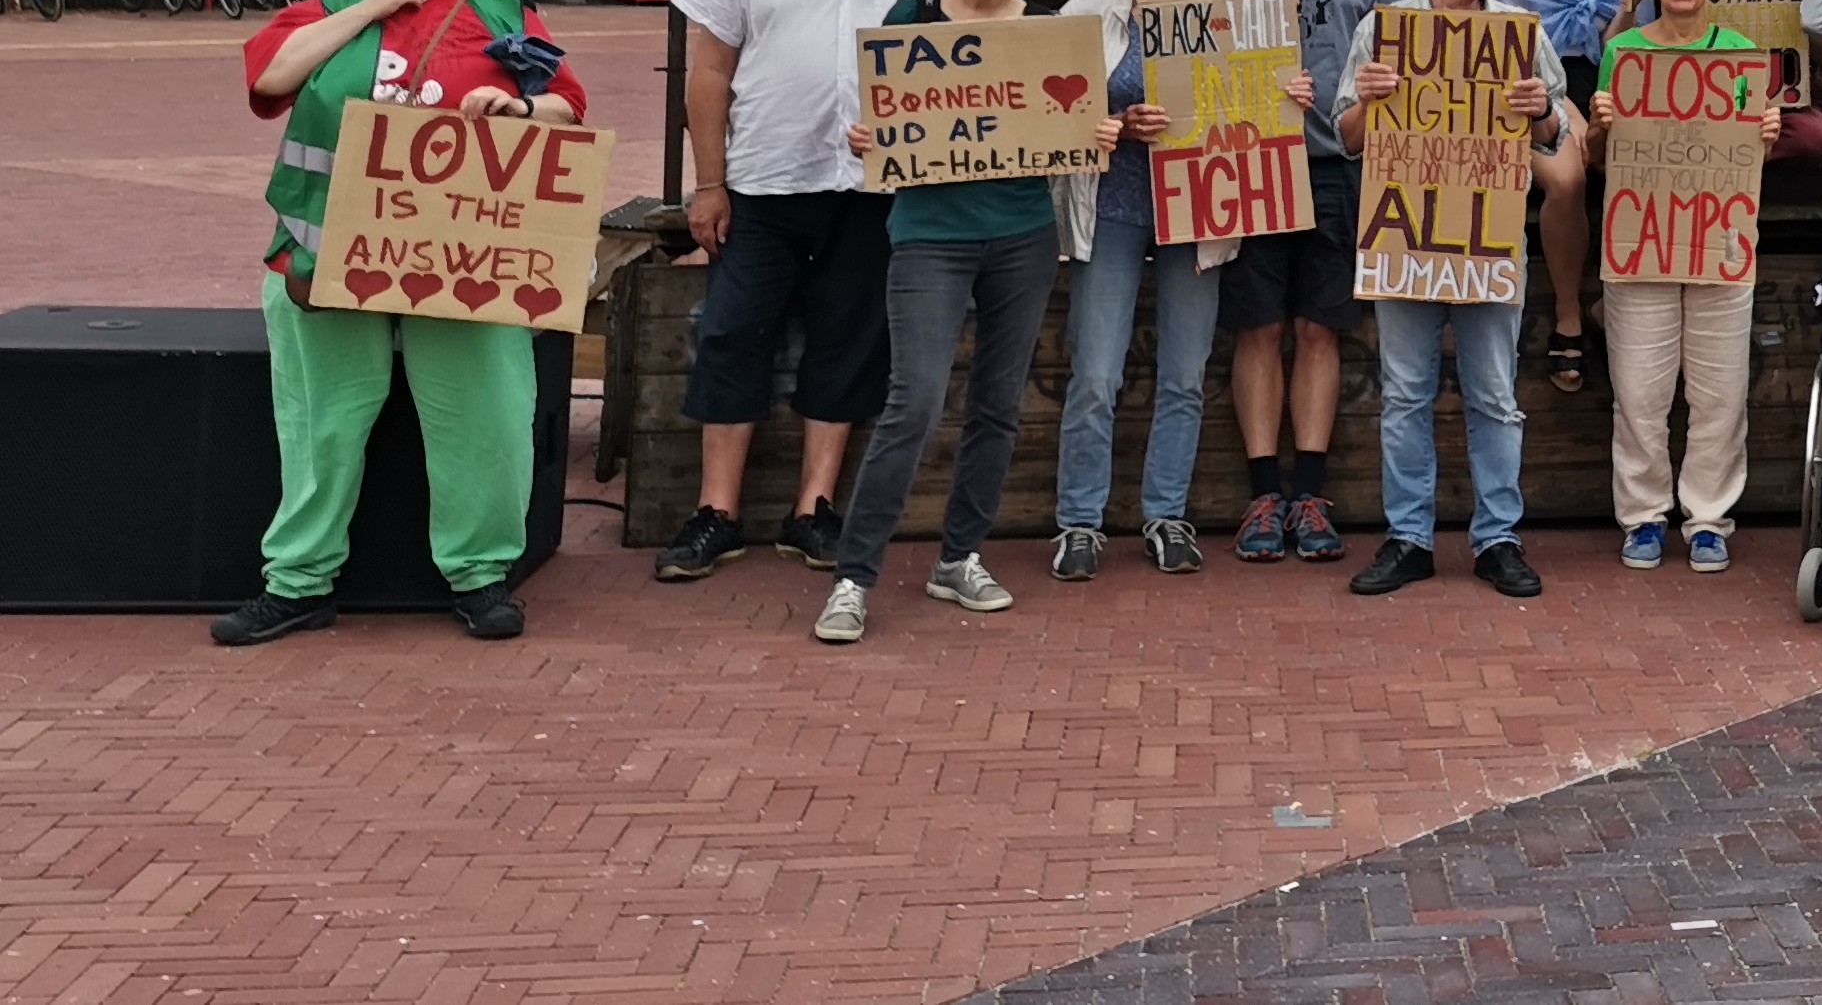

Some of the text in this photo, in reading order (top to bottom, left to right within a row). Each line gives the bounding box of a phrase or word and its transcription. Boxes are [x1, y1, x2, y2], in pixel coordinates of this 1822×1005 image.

[863, 35, 983, 76] TAG
[1142, 2, 1220, 58] BLACK
[1209, 17, 1232, 31] AND
[1373, 10, 1537, 80] HUMAN
[870, 81, 1027, 118] BØRNENE
[1144, 48, 1302, 148] UNITE
[1367, 79, 1531, 139] RIGHTS
[1612, 53, 1766, 122] CLOSE
[875, 116, 998, 147] UD AF
[1204, 121, 1261, 155] AND
[1367, 133, 1419, 160] HAVE
[1422, 137, 1445, 162] NO
[1613, 140, 1756, 167] PRISONS
[1653, 120, 1706, 143] THE
[365, 113, 596, 204] LOVE
[1368, 158, 1417, 184] THEY
[1611, 165, 1666, 189] THAT
[1666, 168, 1706, 192] YOU
[375, 187, 526, 229] IS THE
[1152, 135, 1304, 243] FIGHT
[1359, 180, 1515, 258] ALL
[1605, 188, 1756, 282] CAMPS
[344, 234, 554, 286] ANSWER
[1355, 252, 1517, 303] HUMANS
